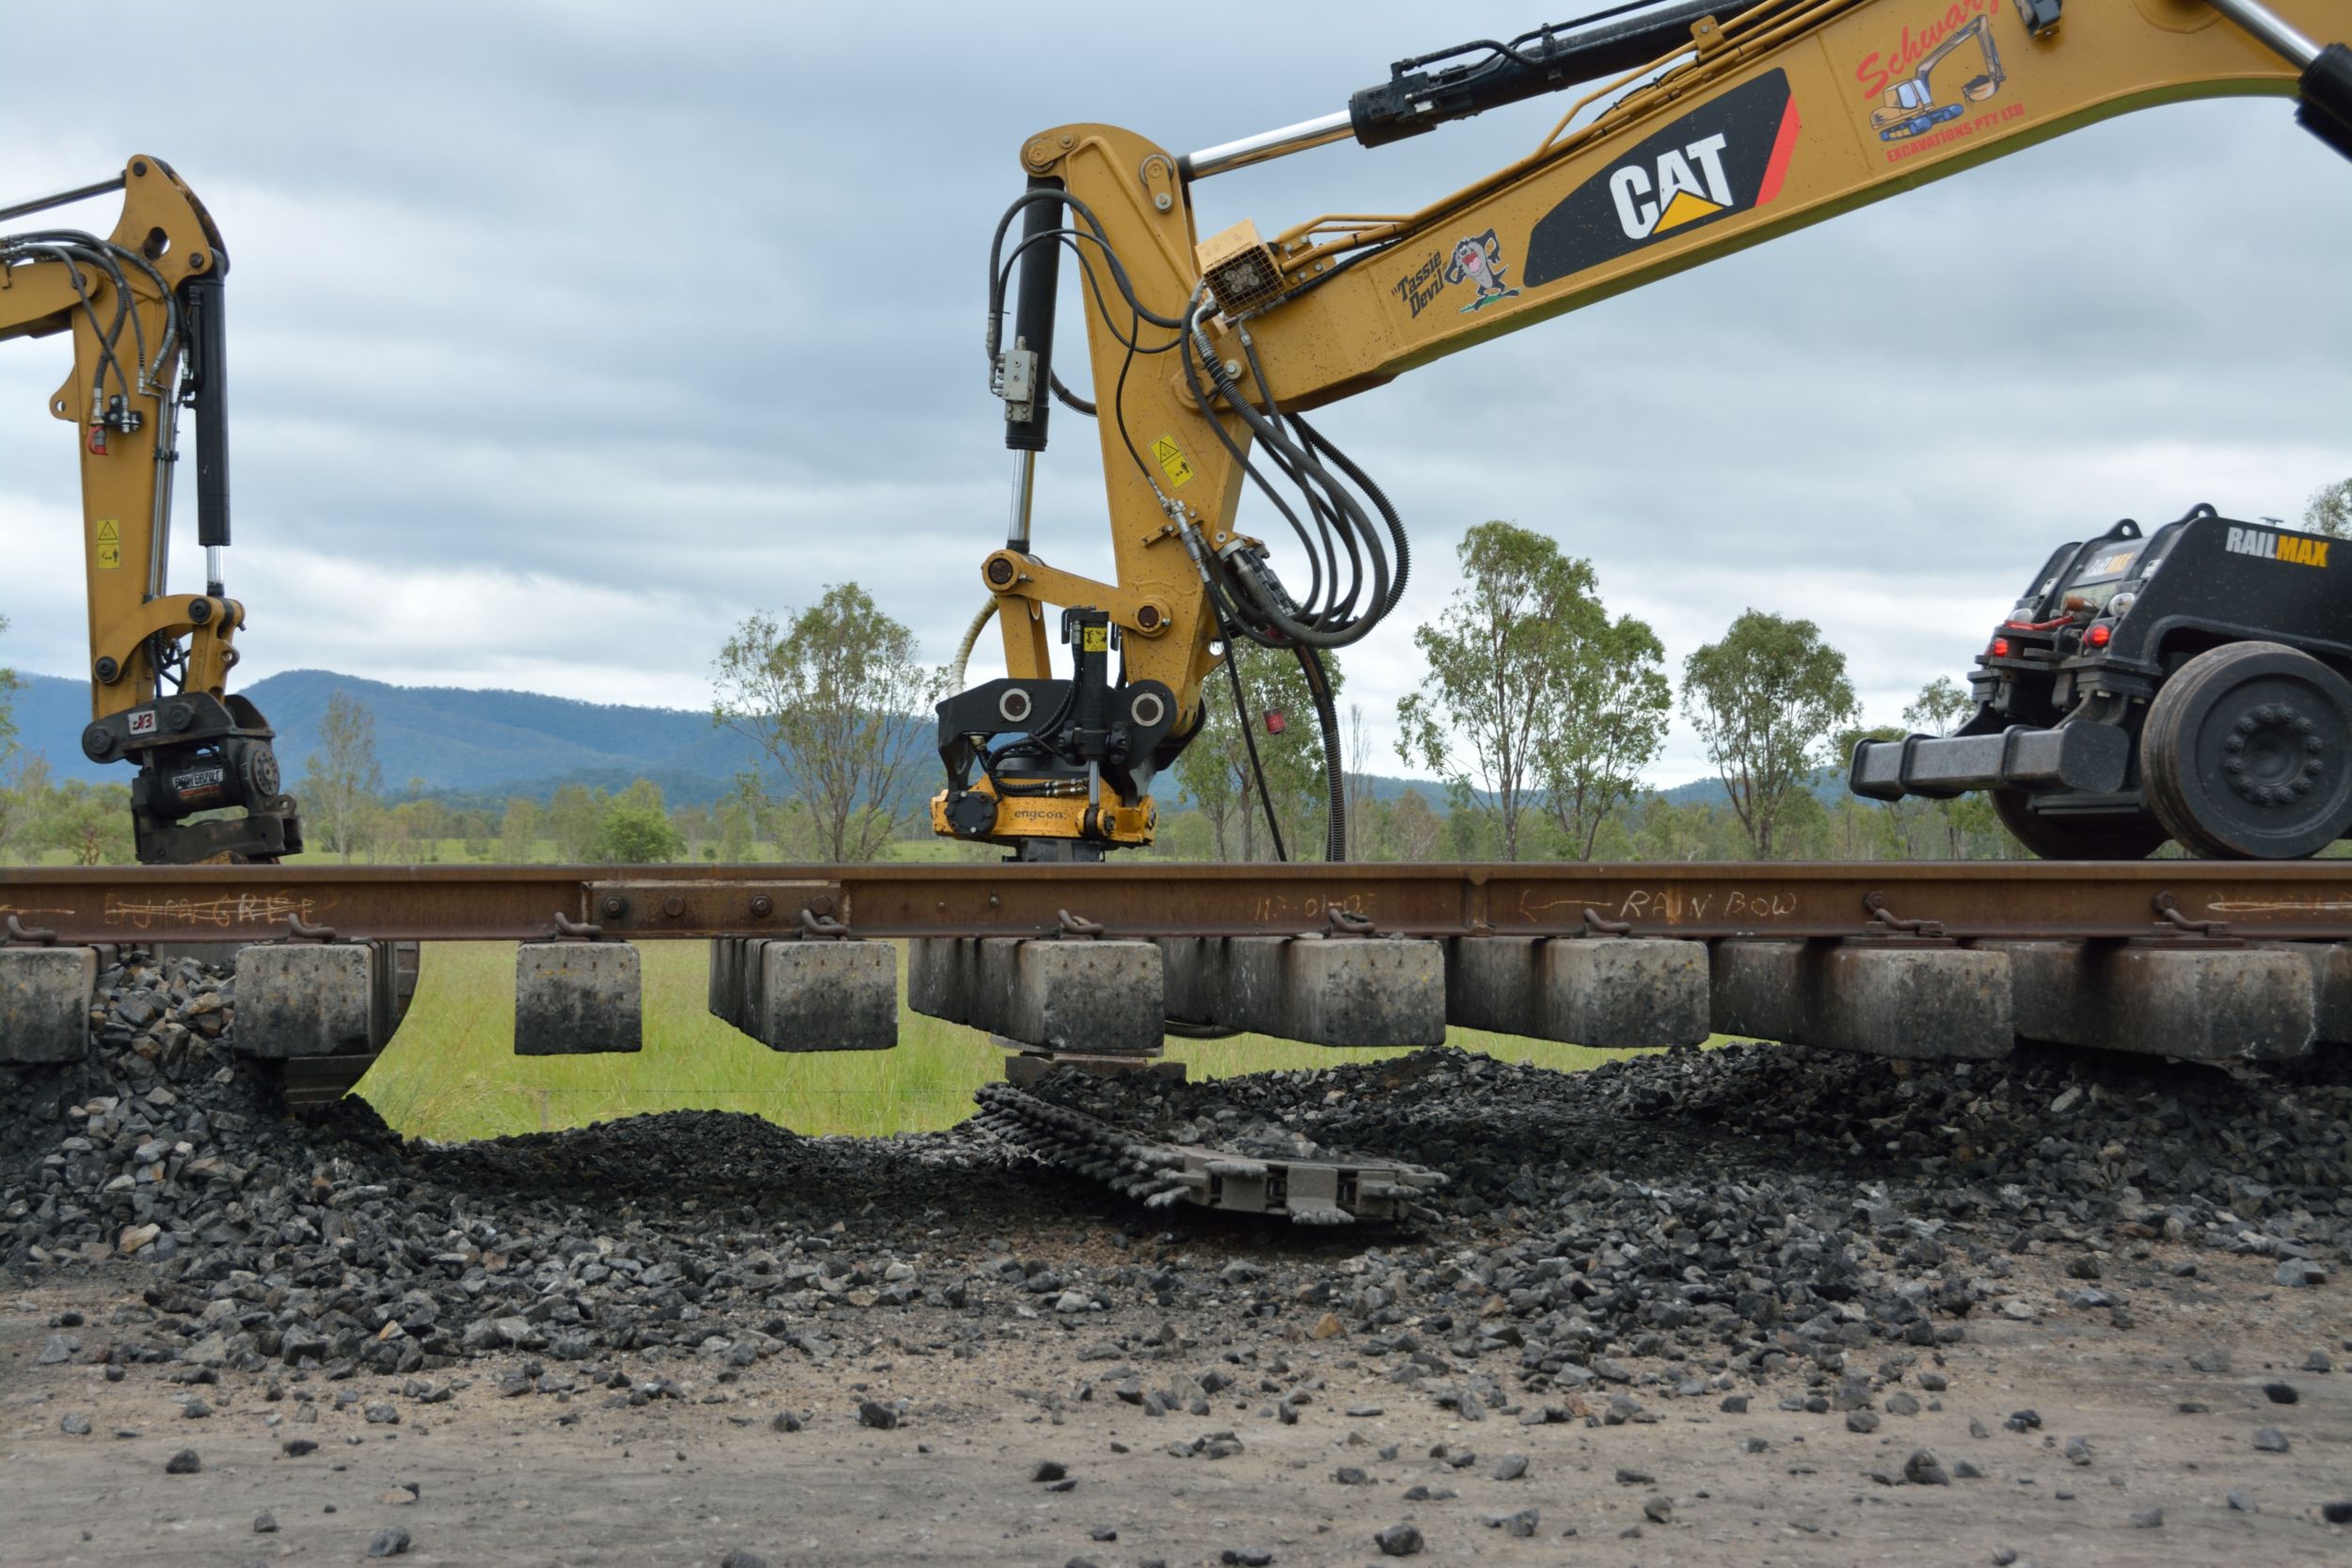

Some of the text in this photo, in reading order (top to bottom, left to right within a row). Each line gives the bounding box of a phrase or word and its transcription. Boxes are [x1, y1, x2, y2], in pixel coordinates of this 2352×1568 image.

[1886, 103, 2025, 164] EXCAVATIONS PTY LTD
[1609, 133, 1734, 240] CAT
[1014, 810, 1063, 820] engcon
